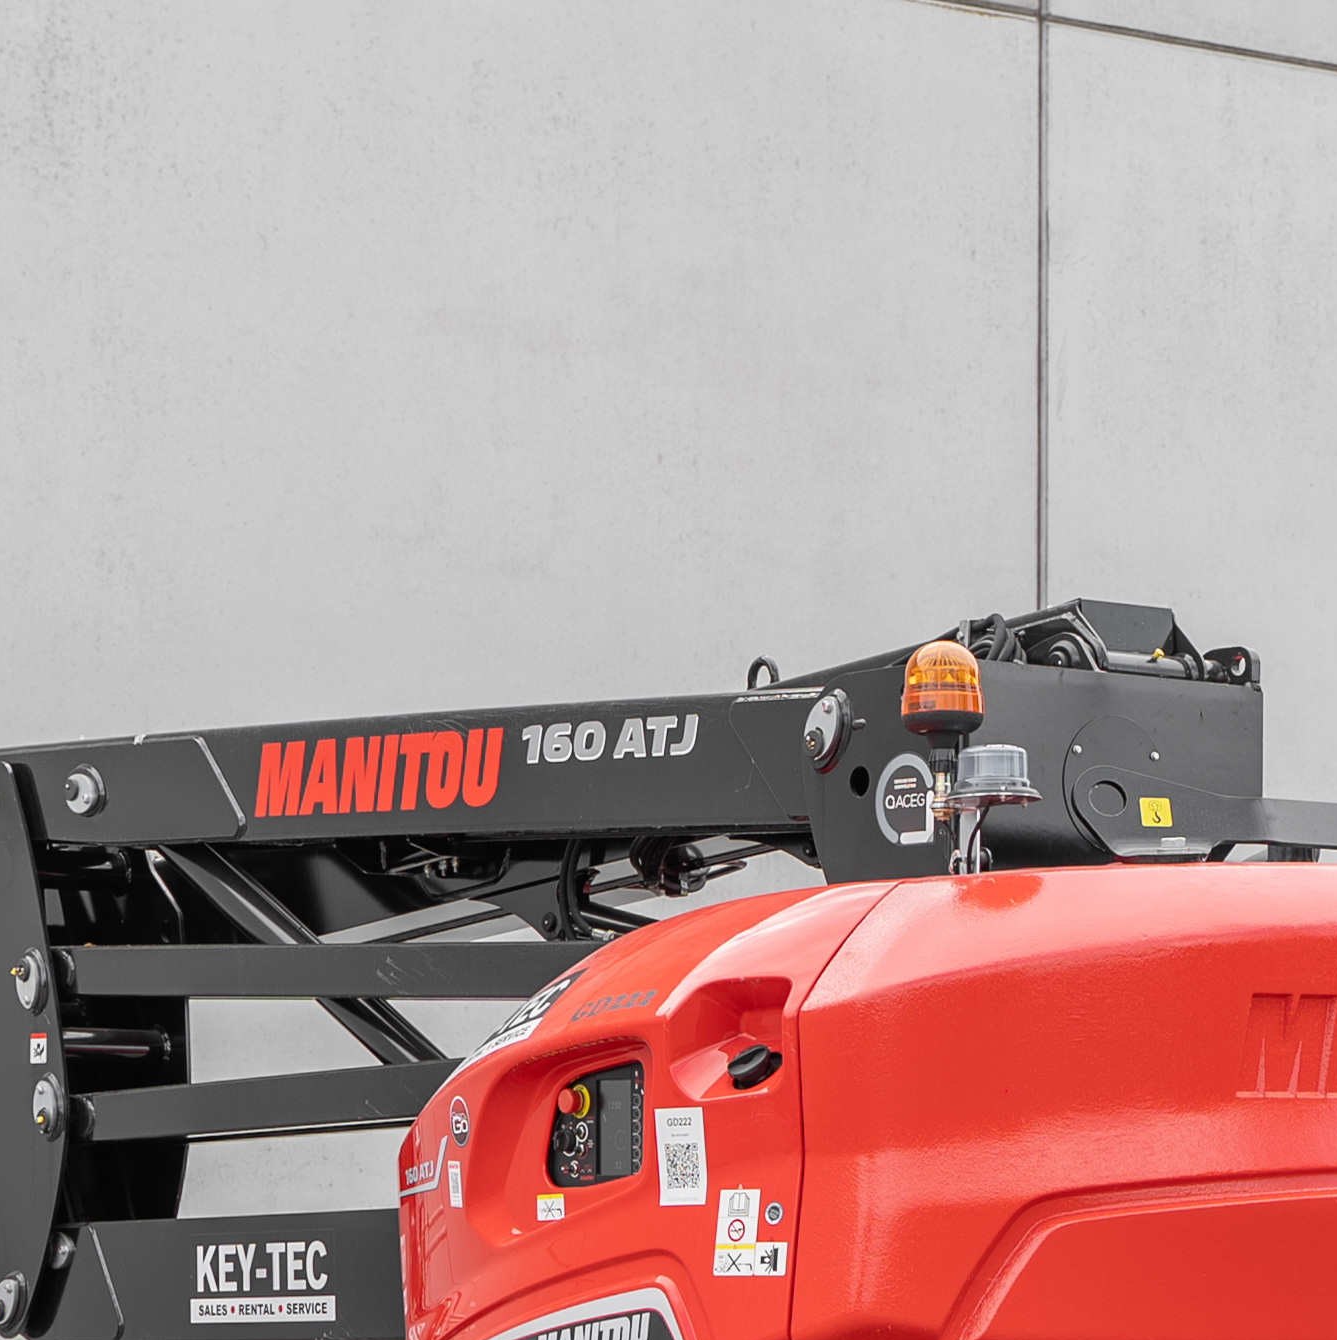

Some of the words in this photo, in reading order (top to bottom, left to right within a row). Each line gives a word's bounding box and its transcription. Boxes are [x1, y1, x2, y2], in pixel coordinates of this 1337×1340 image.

[254, 727, 503, 818] MANITOU
[522, 721, 606, 764] 160
[613, 714, 699, 760] ATJ
[451, 1116, 468, 1134] Go
[666, 1117, 692, 1127] GD222
[405, 1165, 419, 1185] 160
[419, 1160, 434, 1180] ATJ
[196, 1240, 329, 1293] KEY-TEC
[198, 1304, 228, 1317] SALES
[238, 1303, 275, 1316] RENTAL
[286, 1302, 328, 1315] SERVICE
